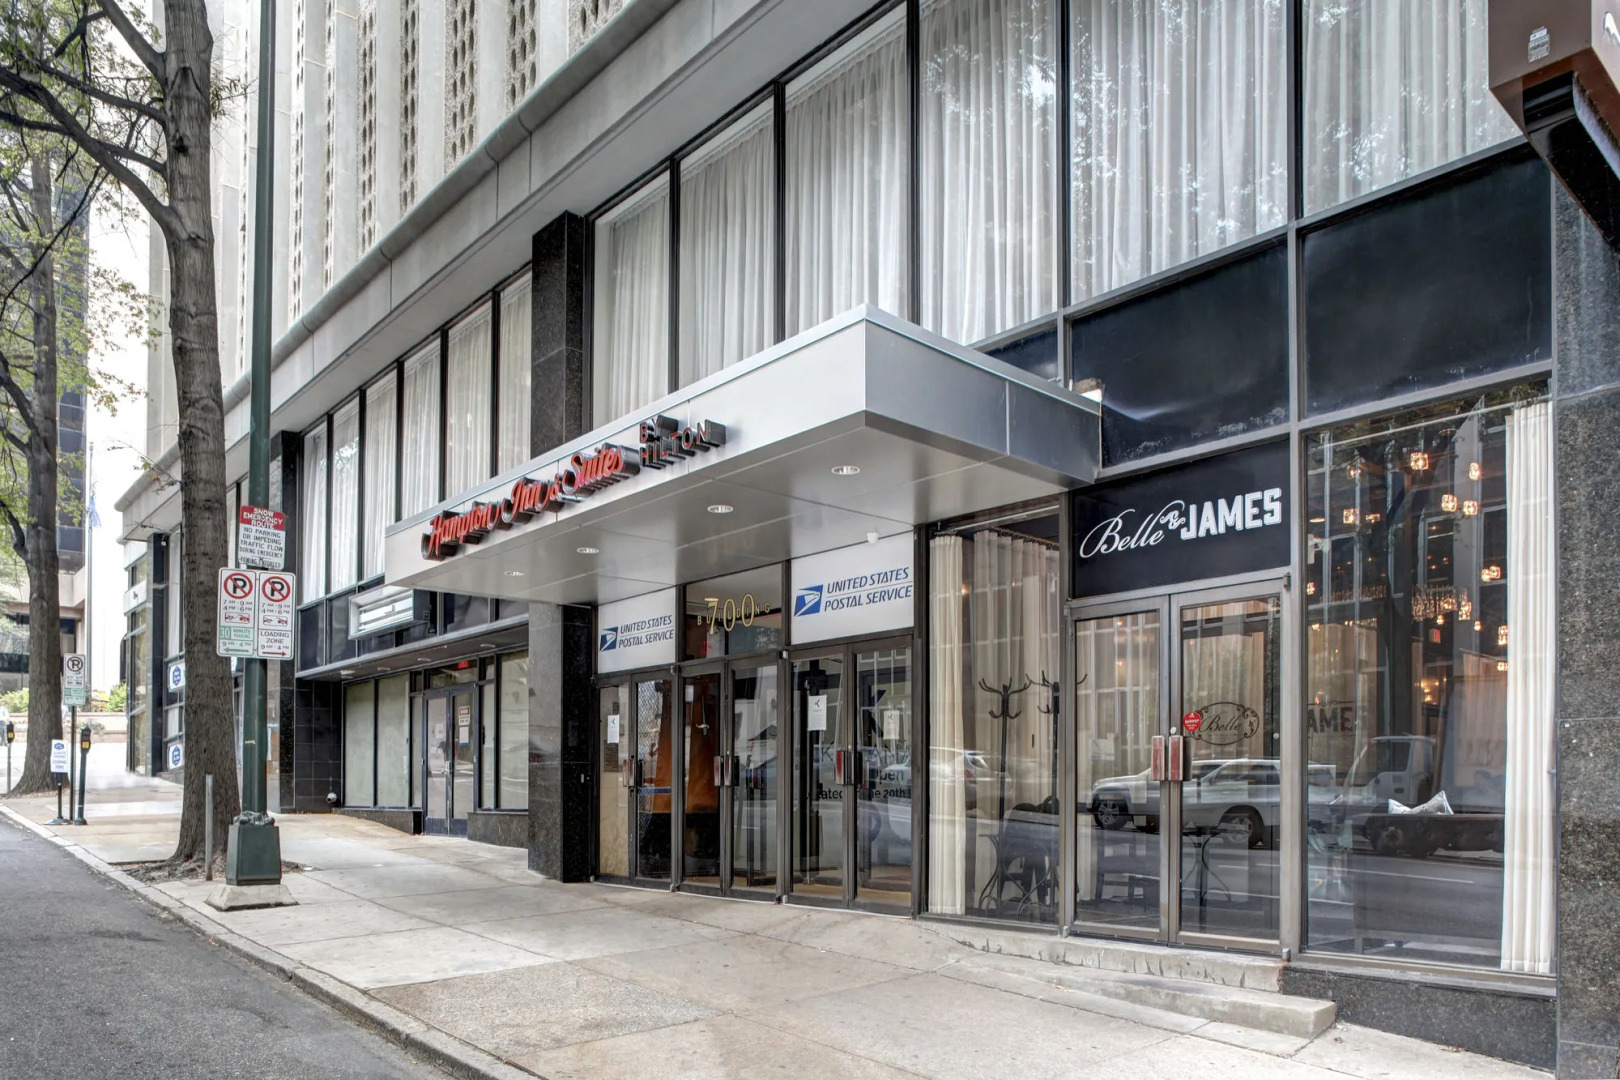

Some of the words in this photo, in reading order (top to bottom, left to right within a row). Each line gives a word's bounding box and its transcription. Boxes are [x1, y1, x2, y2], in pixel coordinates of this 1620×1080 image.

[640, 415, 668, 444] BY
[640, 419, 716, 468] HILTON
[422, 504, 500, 560] Hampton
[501, 477, 552, 524] Inn
[562, 444, 626, 496] Suites
[243, 512, 283, 526] EMERGENCY
[253, 507, 275, 517] SNOW
[251, 520, 275, 530] ROUTE
[1079, 500, 1183, 559] Belle
[1159, 510, 1186, 530] &
[1180, 487, 1282, 541] JAMES
[242, 533, 251, 541] OR
[253, 535, 282, 546] IMPEDING
[255, 529, 281, 539] PARKING
[239, 546, 256, 554] DURING
[257, 549, 284, 559] EMERGENCY
[240, 539, 264, 549] TRAFFIC
[267, 544, 284, 553] FLOW
[827, 575, 868, 594] UNITED
[869, 566, 909, 587] STATES
[824, 594, 863, 612] POSTAL
[866, 585, 913, 605] SERVICE
[707, 593, 754, 635] 700
[620, 620, 647, 634] UNITED
[647, 615, 672, 629] STATES
[619, 636, 643, 648] POSTAL
[645, 629, 674, 644] SERVICE
[1200, 712, 1241, 733] Belle
[1307, 706, 1360, 733] AME
[884, 787, 906, 798] 20th
